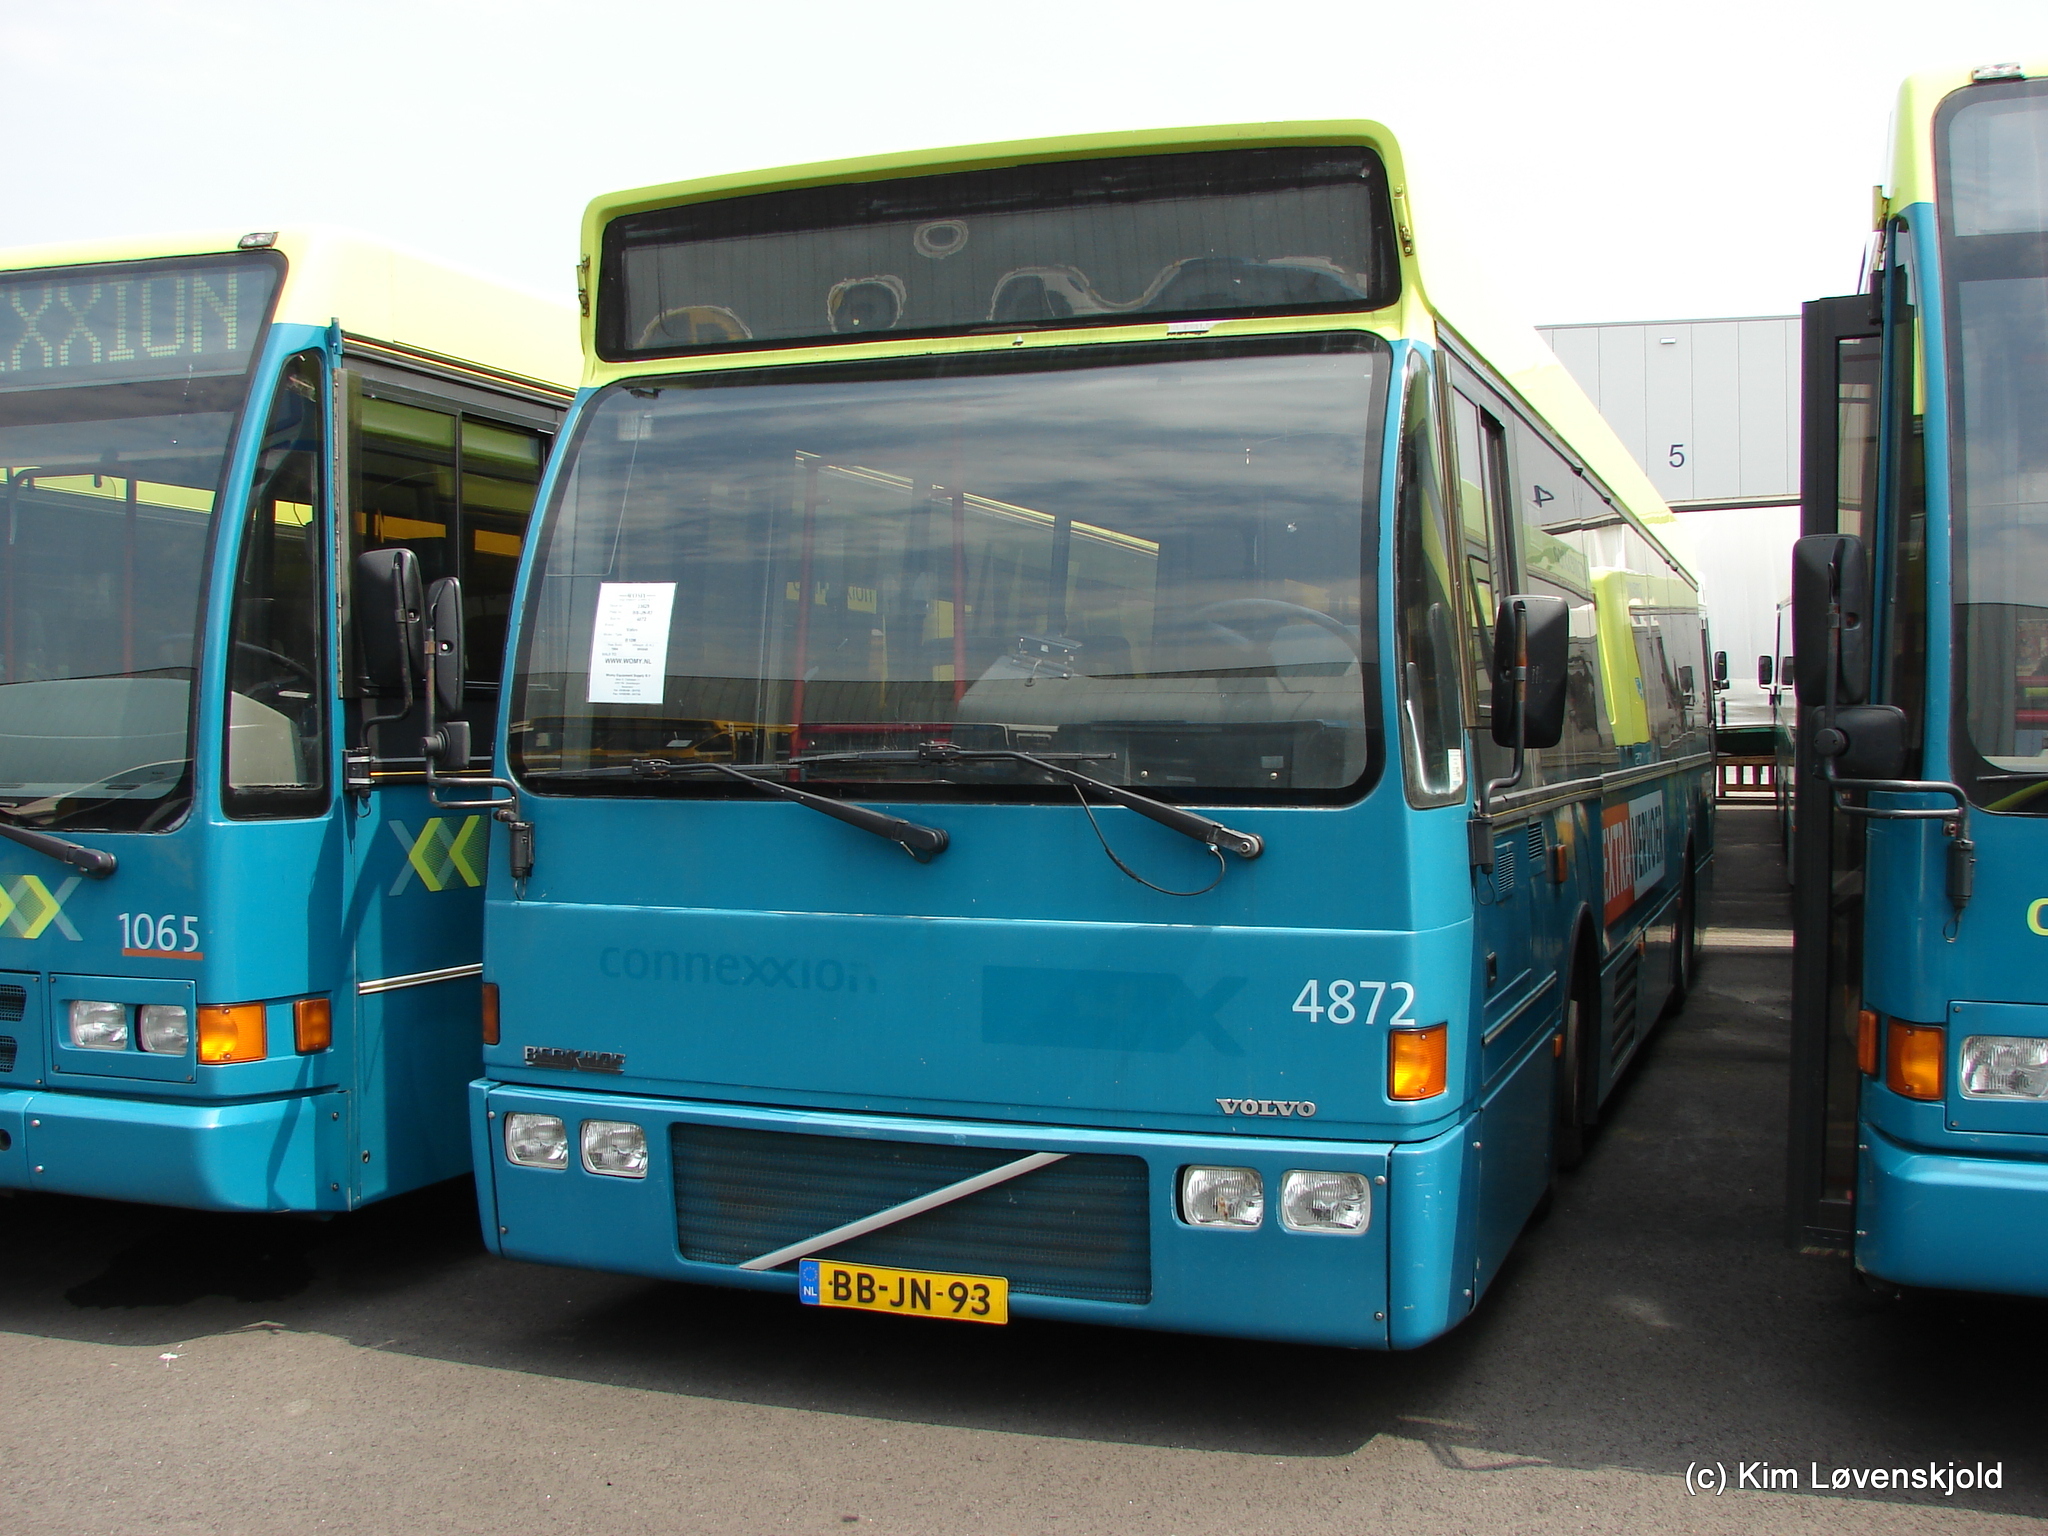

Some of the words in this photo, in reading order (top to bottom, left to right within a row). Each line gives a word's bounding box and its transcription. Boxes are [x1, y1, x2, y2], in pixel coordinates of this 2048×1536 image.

[0, 269, 238, 372] XXION
[1668, 444, 1685, 468] 5
[118, 912, 200, 953] 1065
[601, 946, 877, 994] connexxion
[1291, 978, 1417, 1026] 4872
[1215, 1097, 1317, 1117] VOLVO
[803, 1285, 818, 1297] NL
[832, 1269, 991, 1315] BB-JN-93
